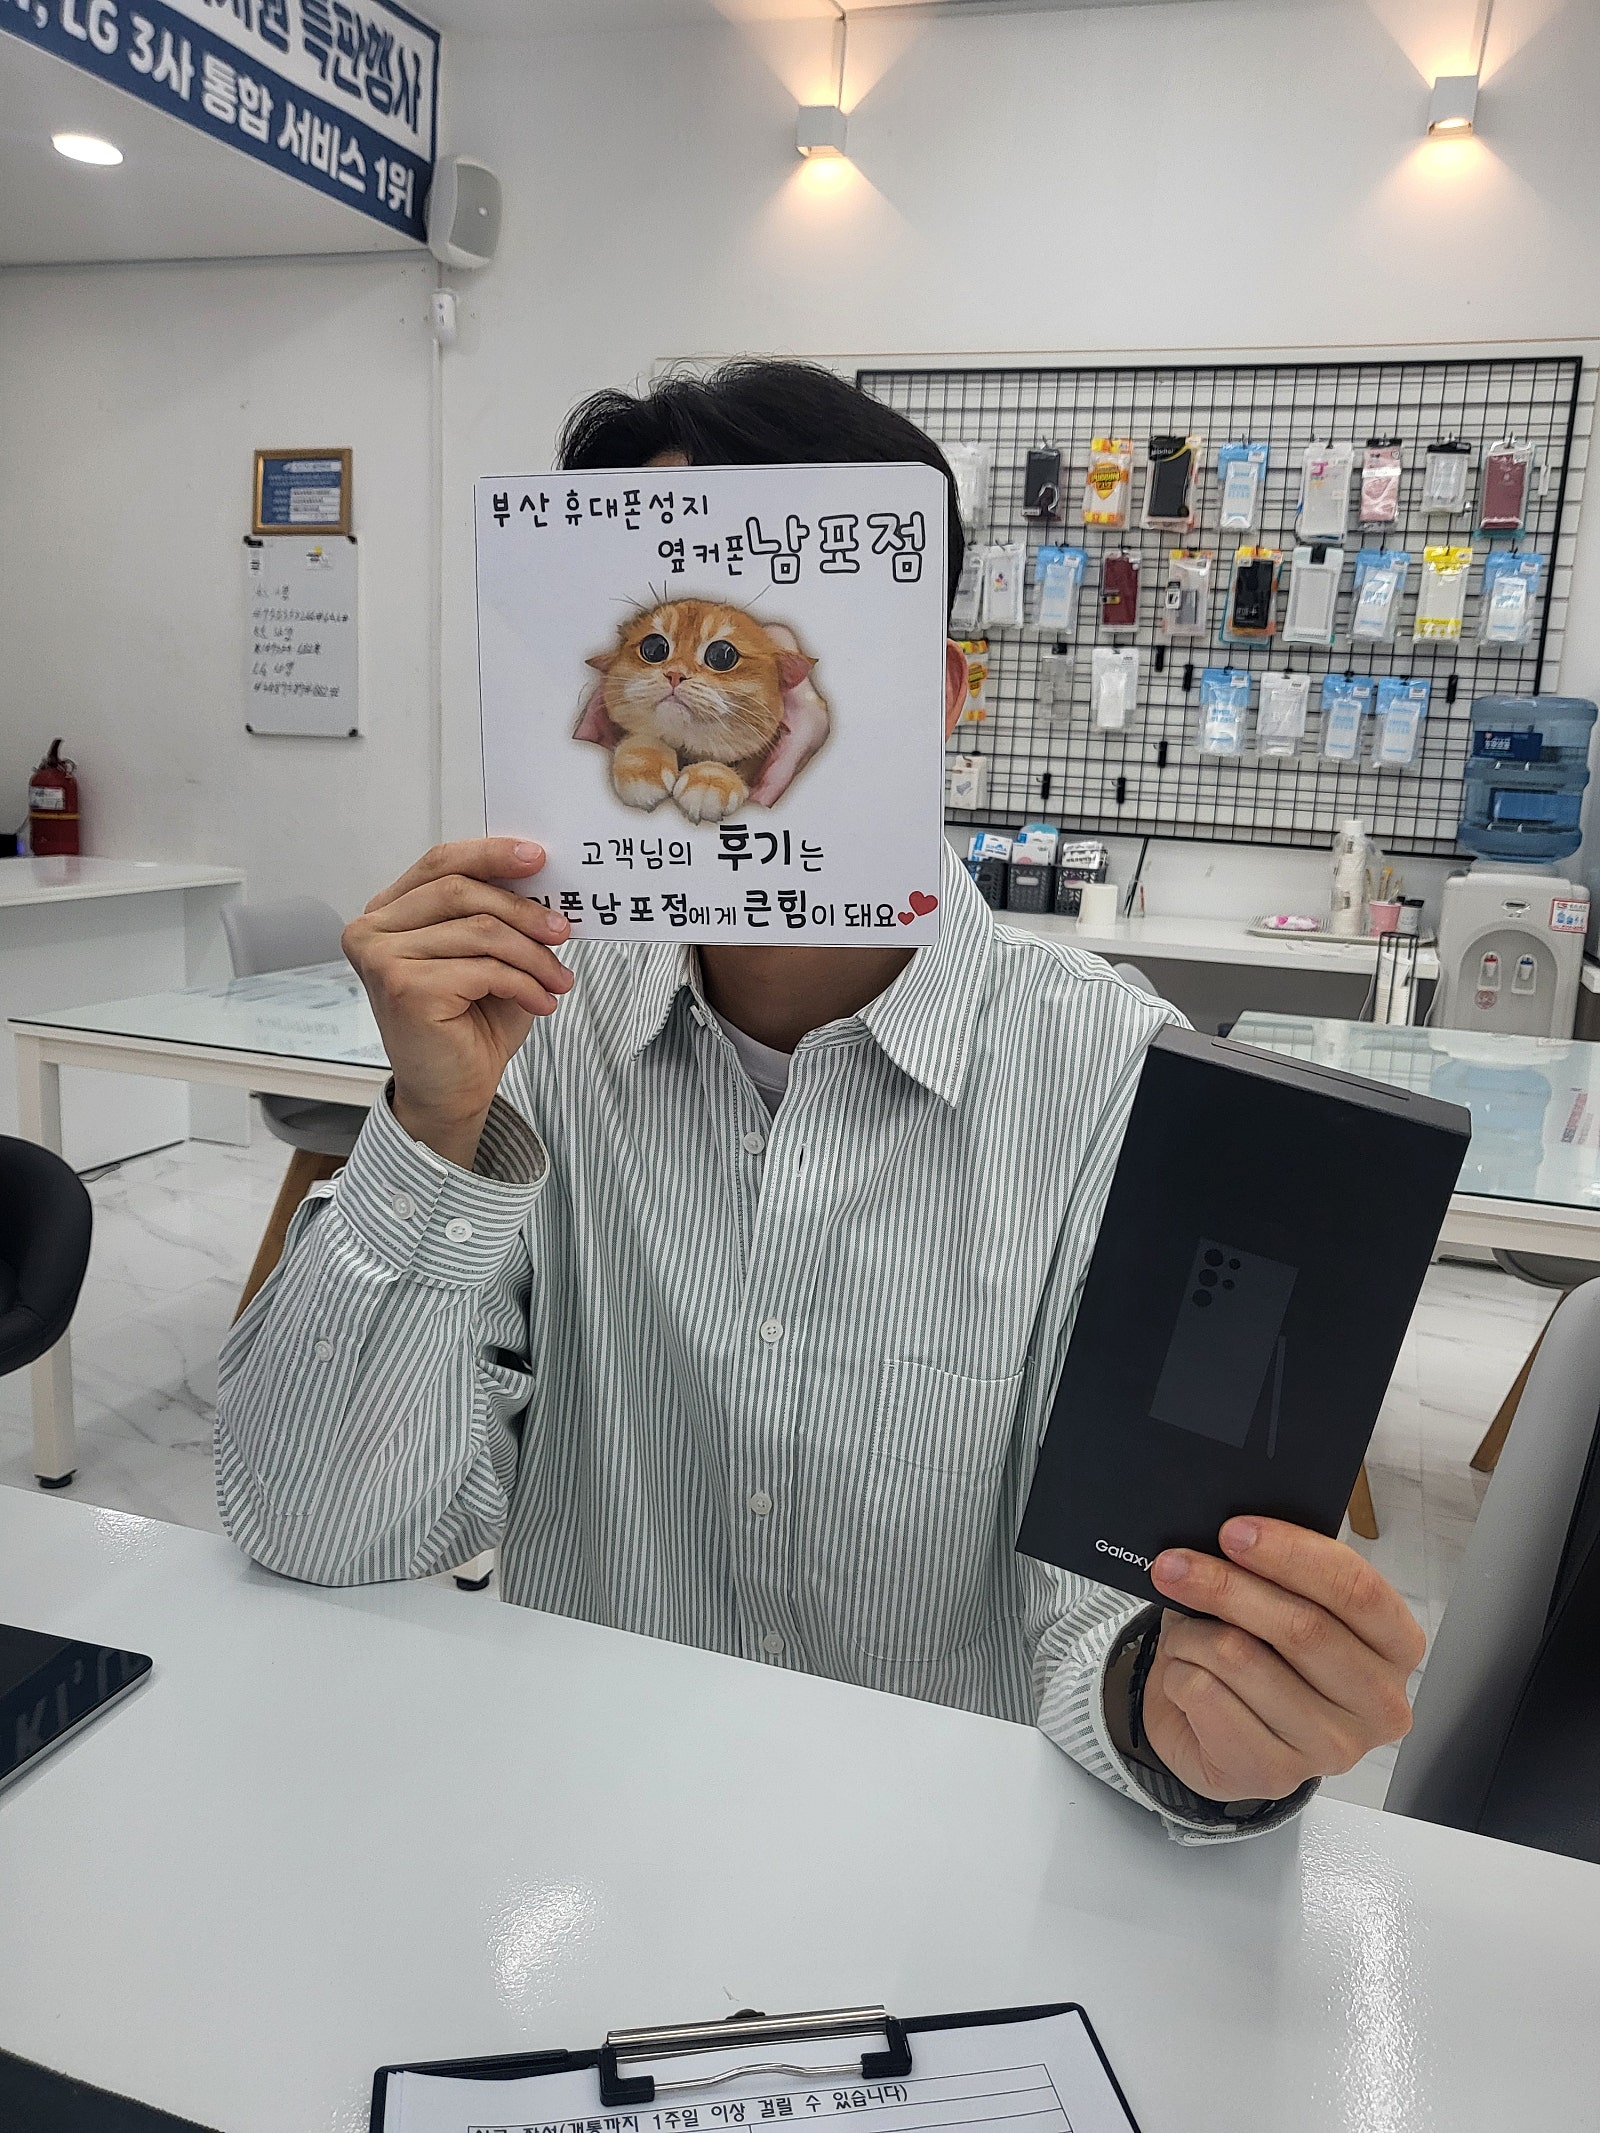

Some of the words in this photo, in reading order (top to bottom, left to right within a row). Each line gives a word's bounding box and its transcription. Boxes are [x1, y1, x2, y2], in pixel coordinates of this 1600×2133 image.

[60, 0, 119, 54] LG
[128, 11, 195, 101] 3사
[202, 51, 274, 144] 통합
[277, 101, 367, 194] 서비스
[374, 156, 415, 219] 1위
[492, 491, 550, 528] 부산
[565, 488, 708, 531] 휴대폰성지
[581, 837, 693, 870] 고객님의
[717, 823, 825, 872] 후기는
[844, 902, 897, 928] 돼요
[1095, 1539, 1154, 1572] Galaxy
[653, 2107, 700, 2131] 1주일
[711, 2103, 746, 2124] 이상
[758, 2096, 794, 2119] 걸릴
[805, 2094, 823, 2113] 수
[832, 2084, 908, 2110] 있습니다)
